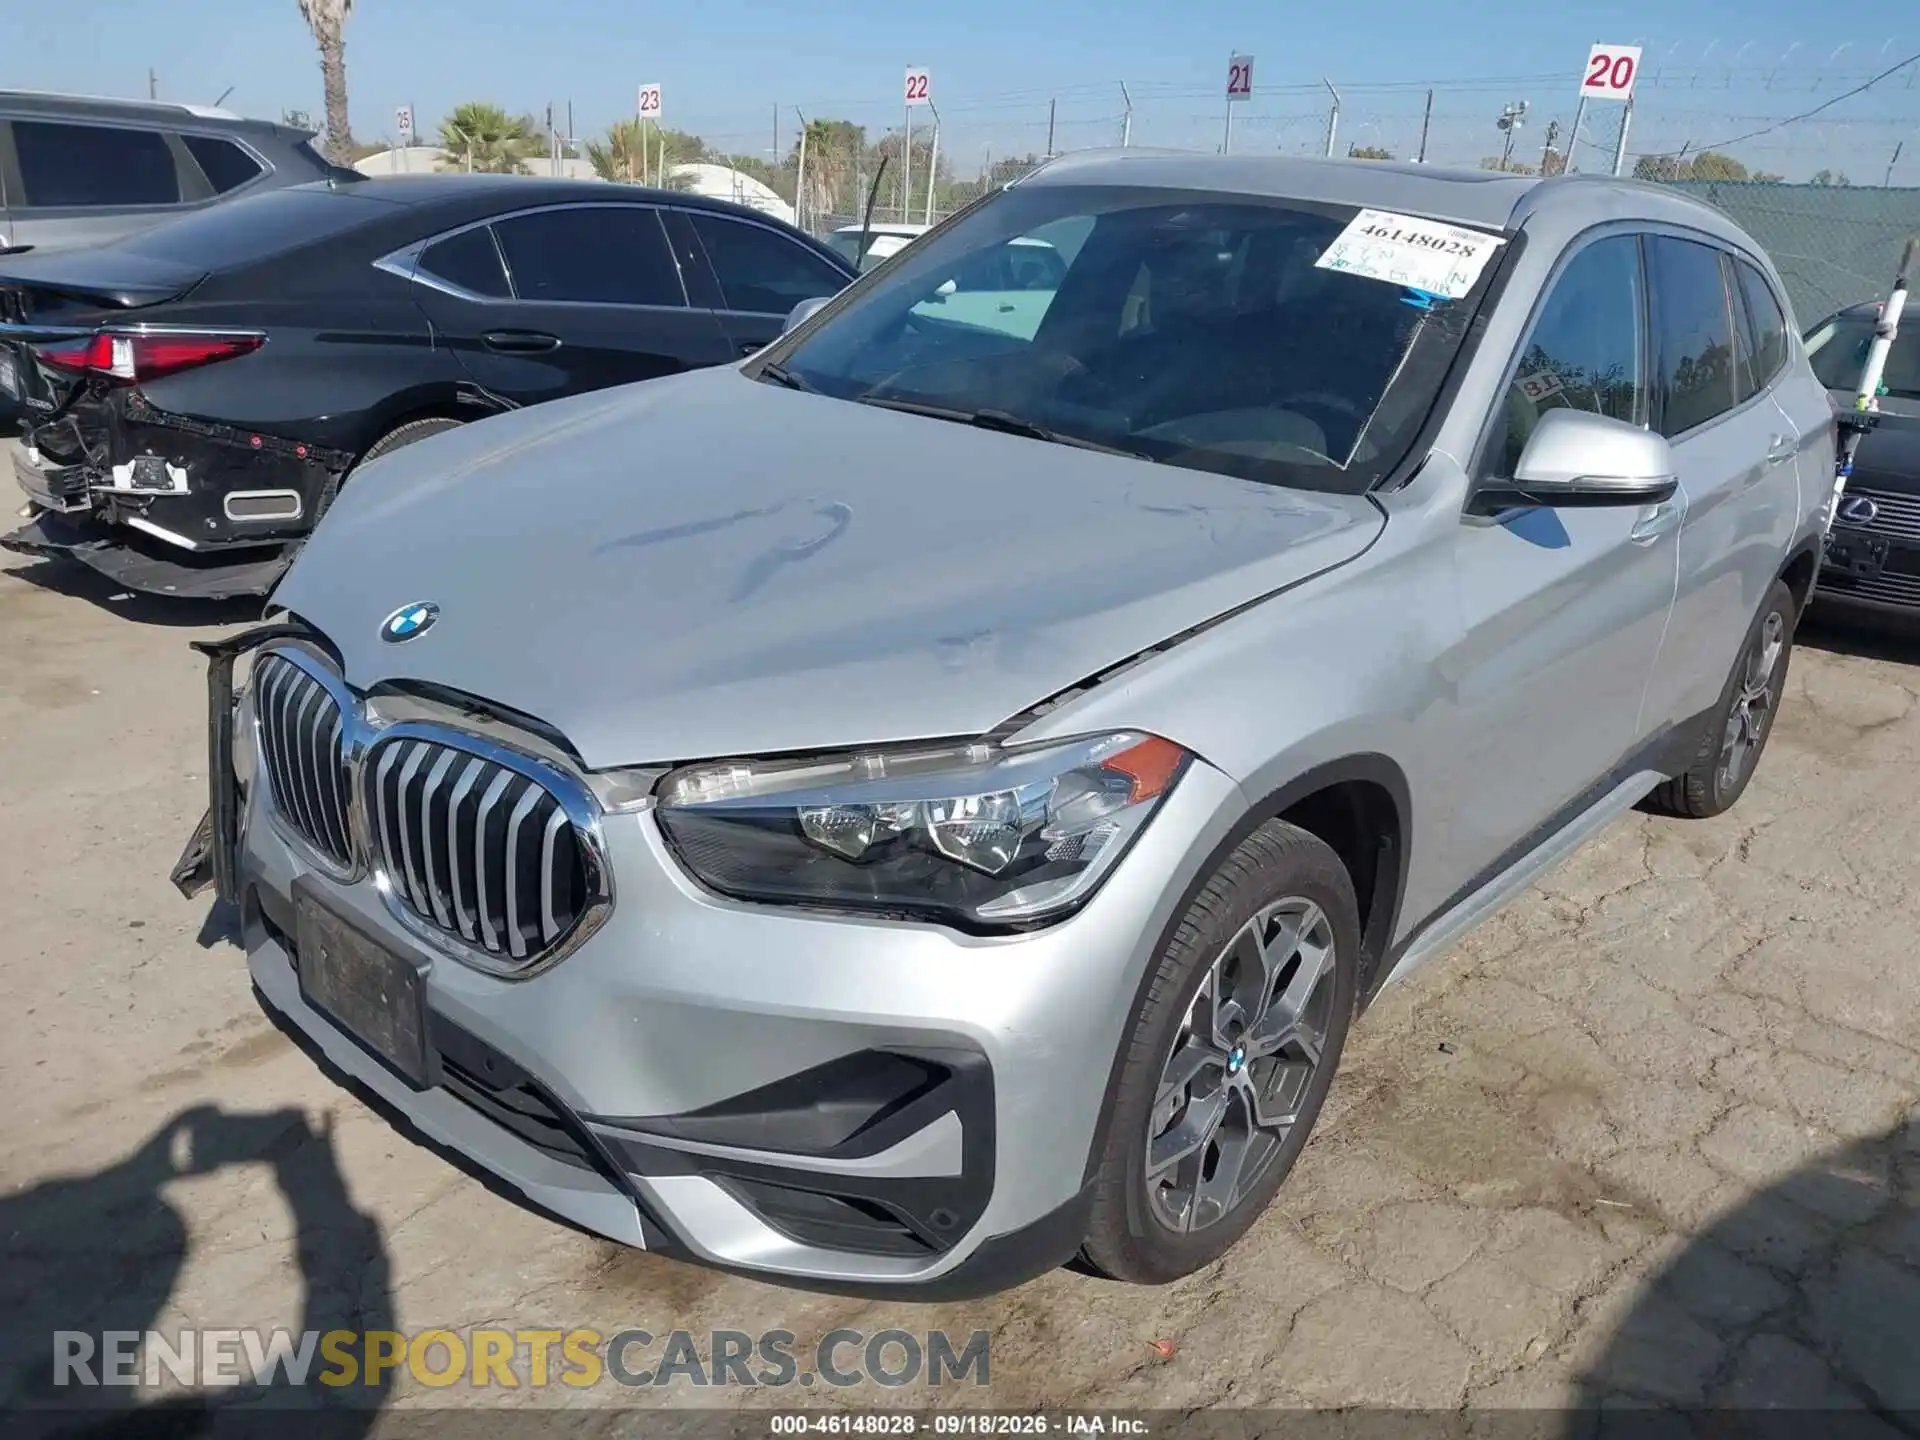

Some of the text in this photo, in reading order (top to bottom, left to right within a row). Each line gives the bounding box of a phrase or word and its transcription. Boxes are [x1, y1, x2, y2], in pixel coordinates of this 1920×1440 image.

[1228, 64, 1250, 93] 21
[1585, 54, 1633, 89] 20
[641, 90, 659, 110] 23
[907, 75, 927, 98] 22
[1359, 223, 1477, 258] 46148028
